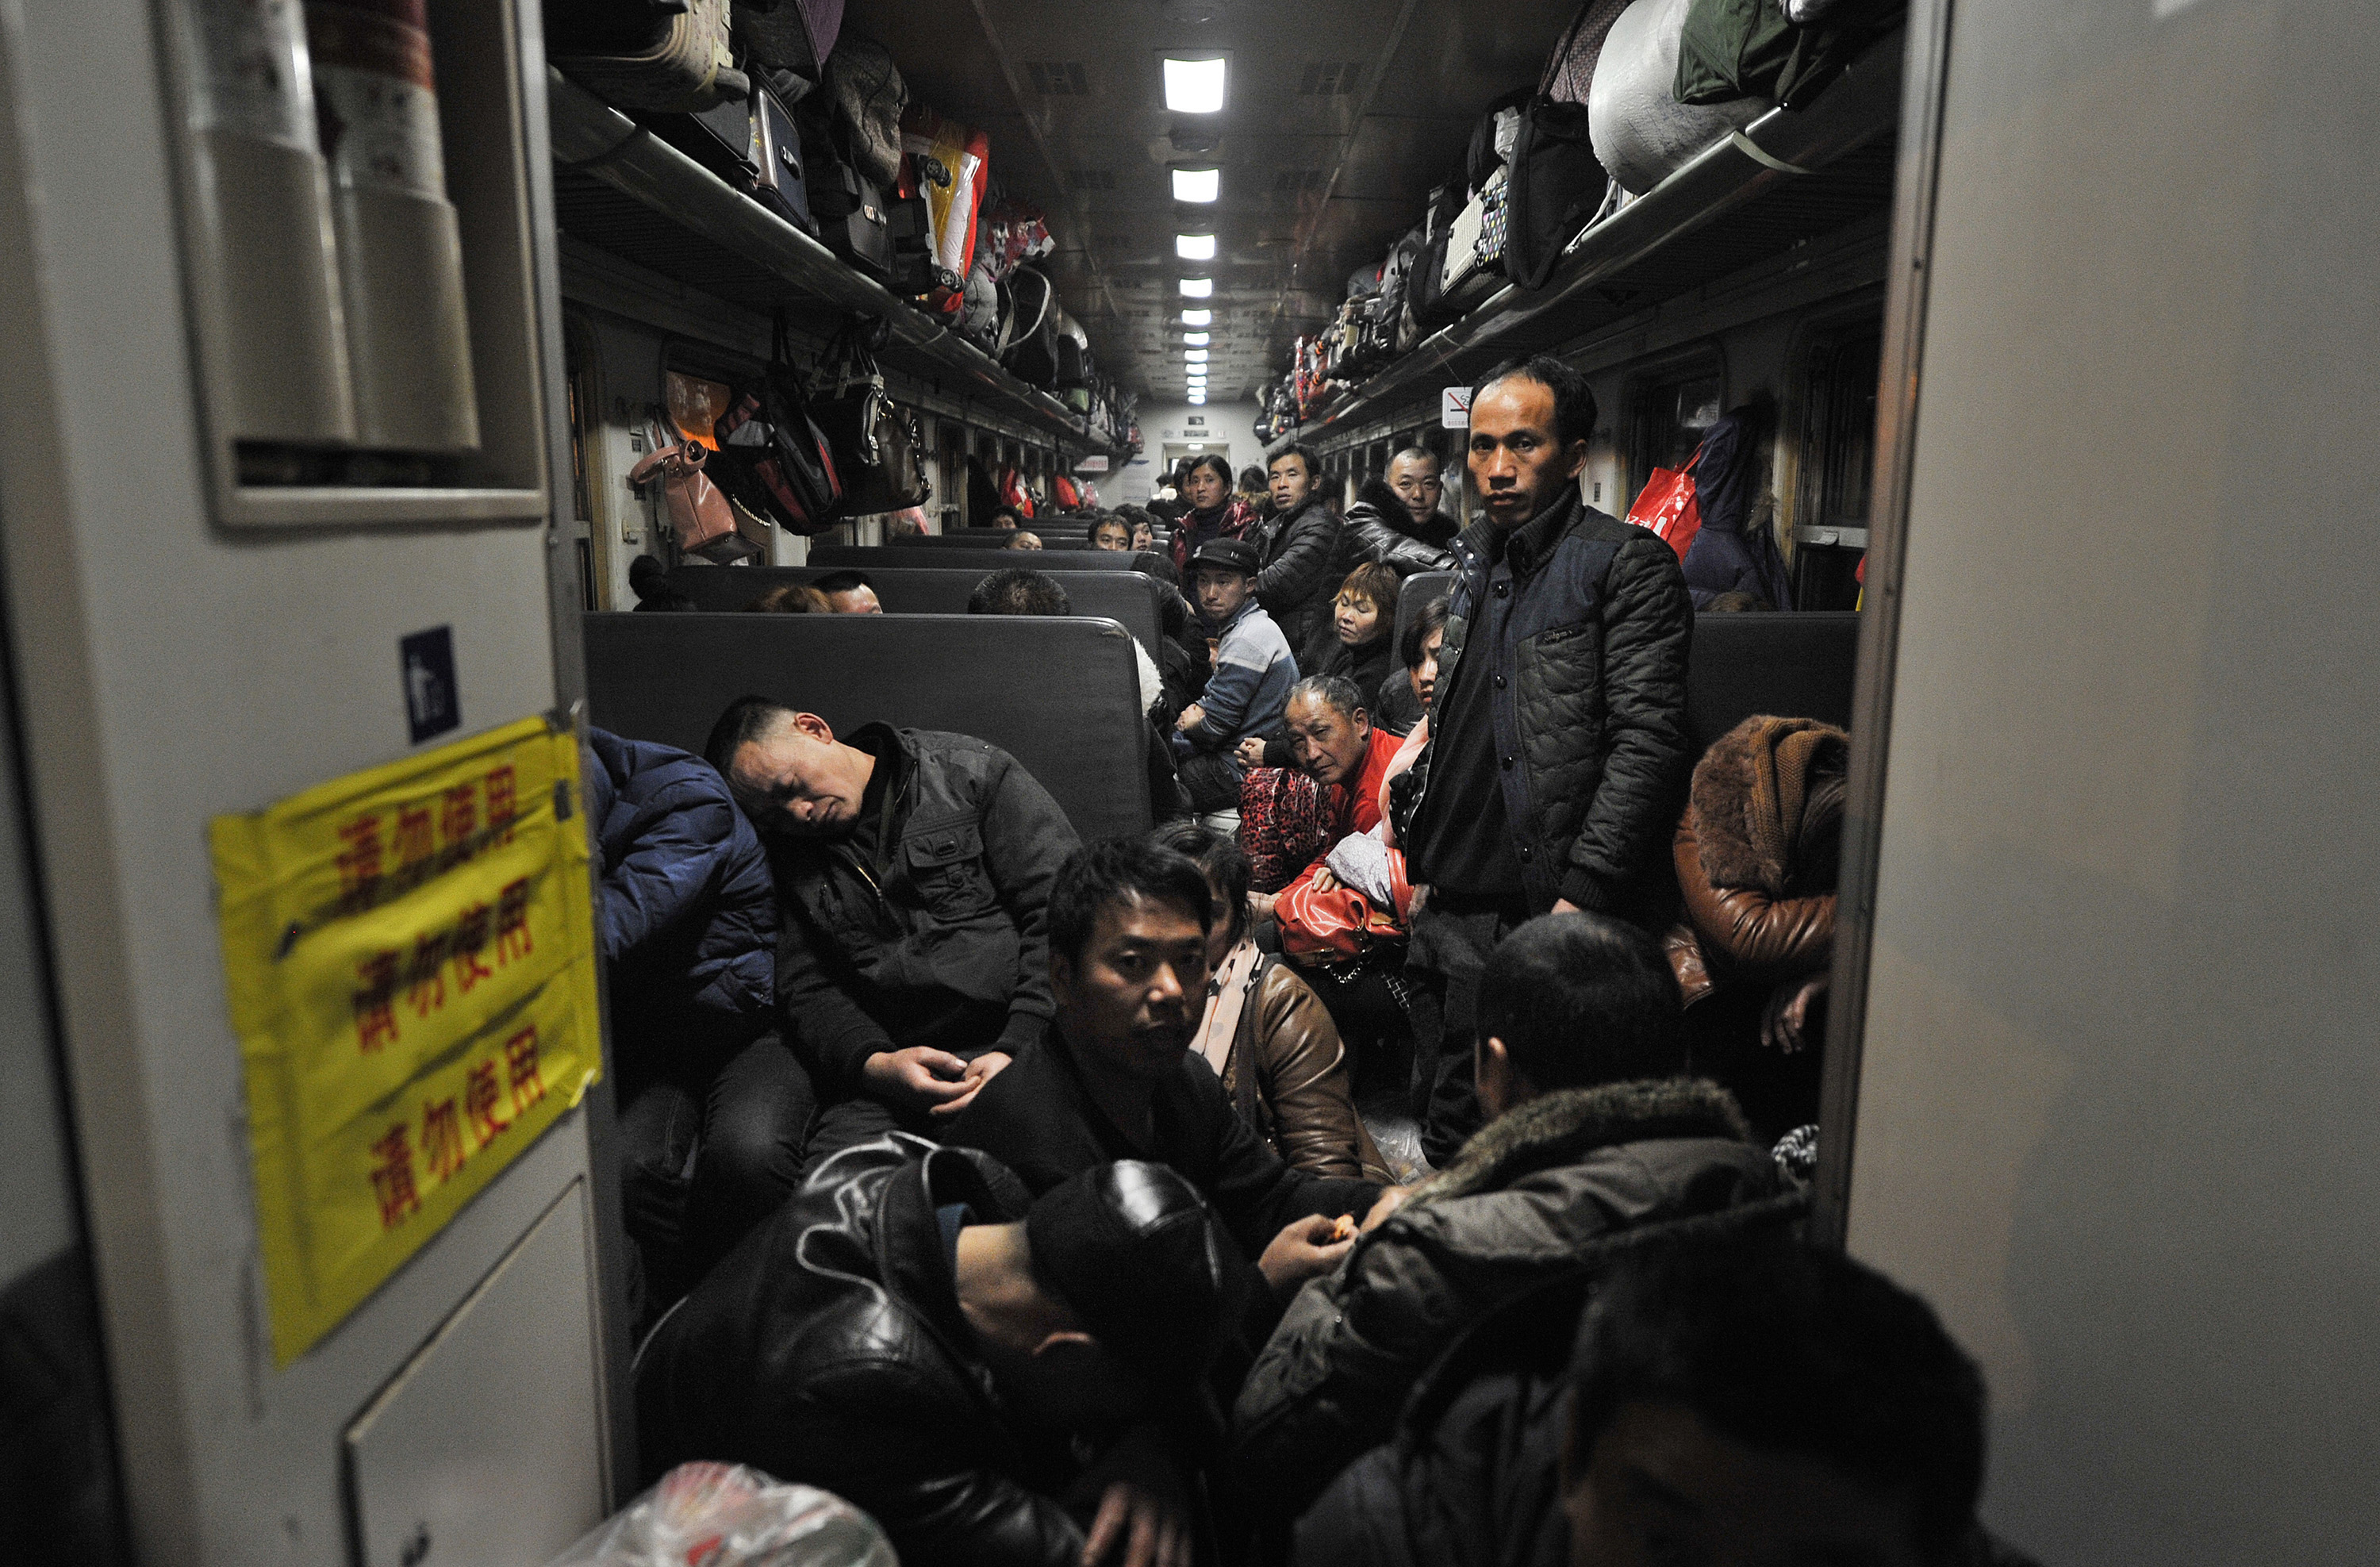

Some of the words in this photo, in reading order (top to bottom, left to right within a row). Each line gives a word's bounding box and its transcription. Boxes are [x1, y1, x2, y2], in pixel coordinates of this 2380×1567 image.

[351, 876, 531, 1054] 请勿使用
[370, 1024, 547, 1230] 请勿使用
